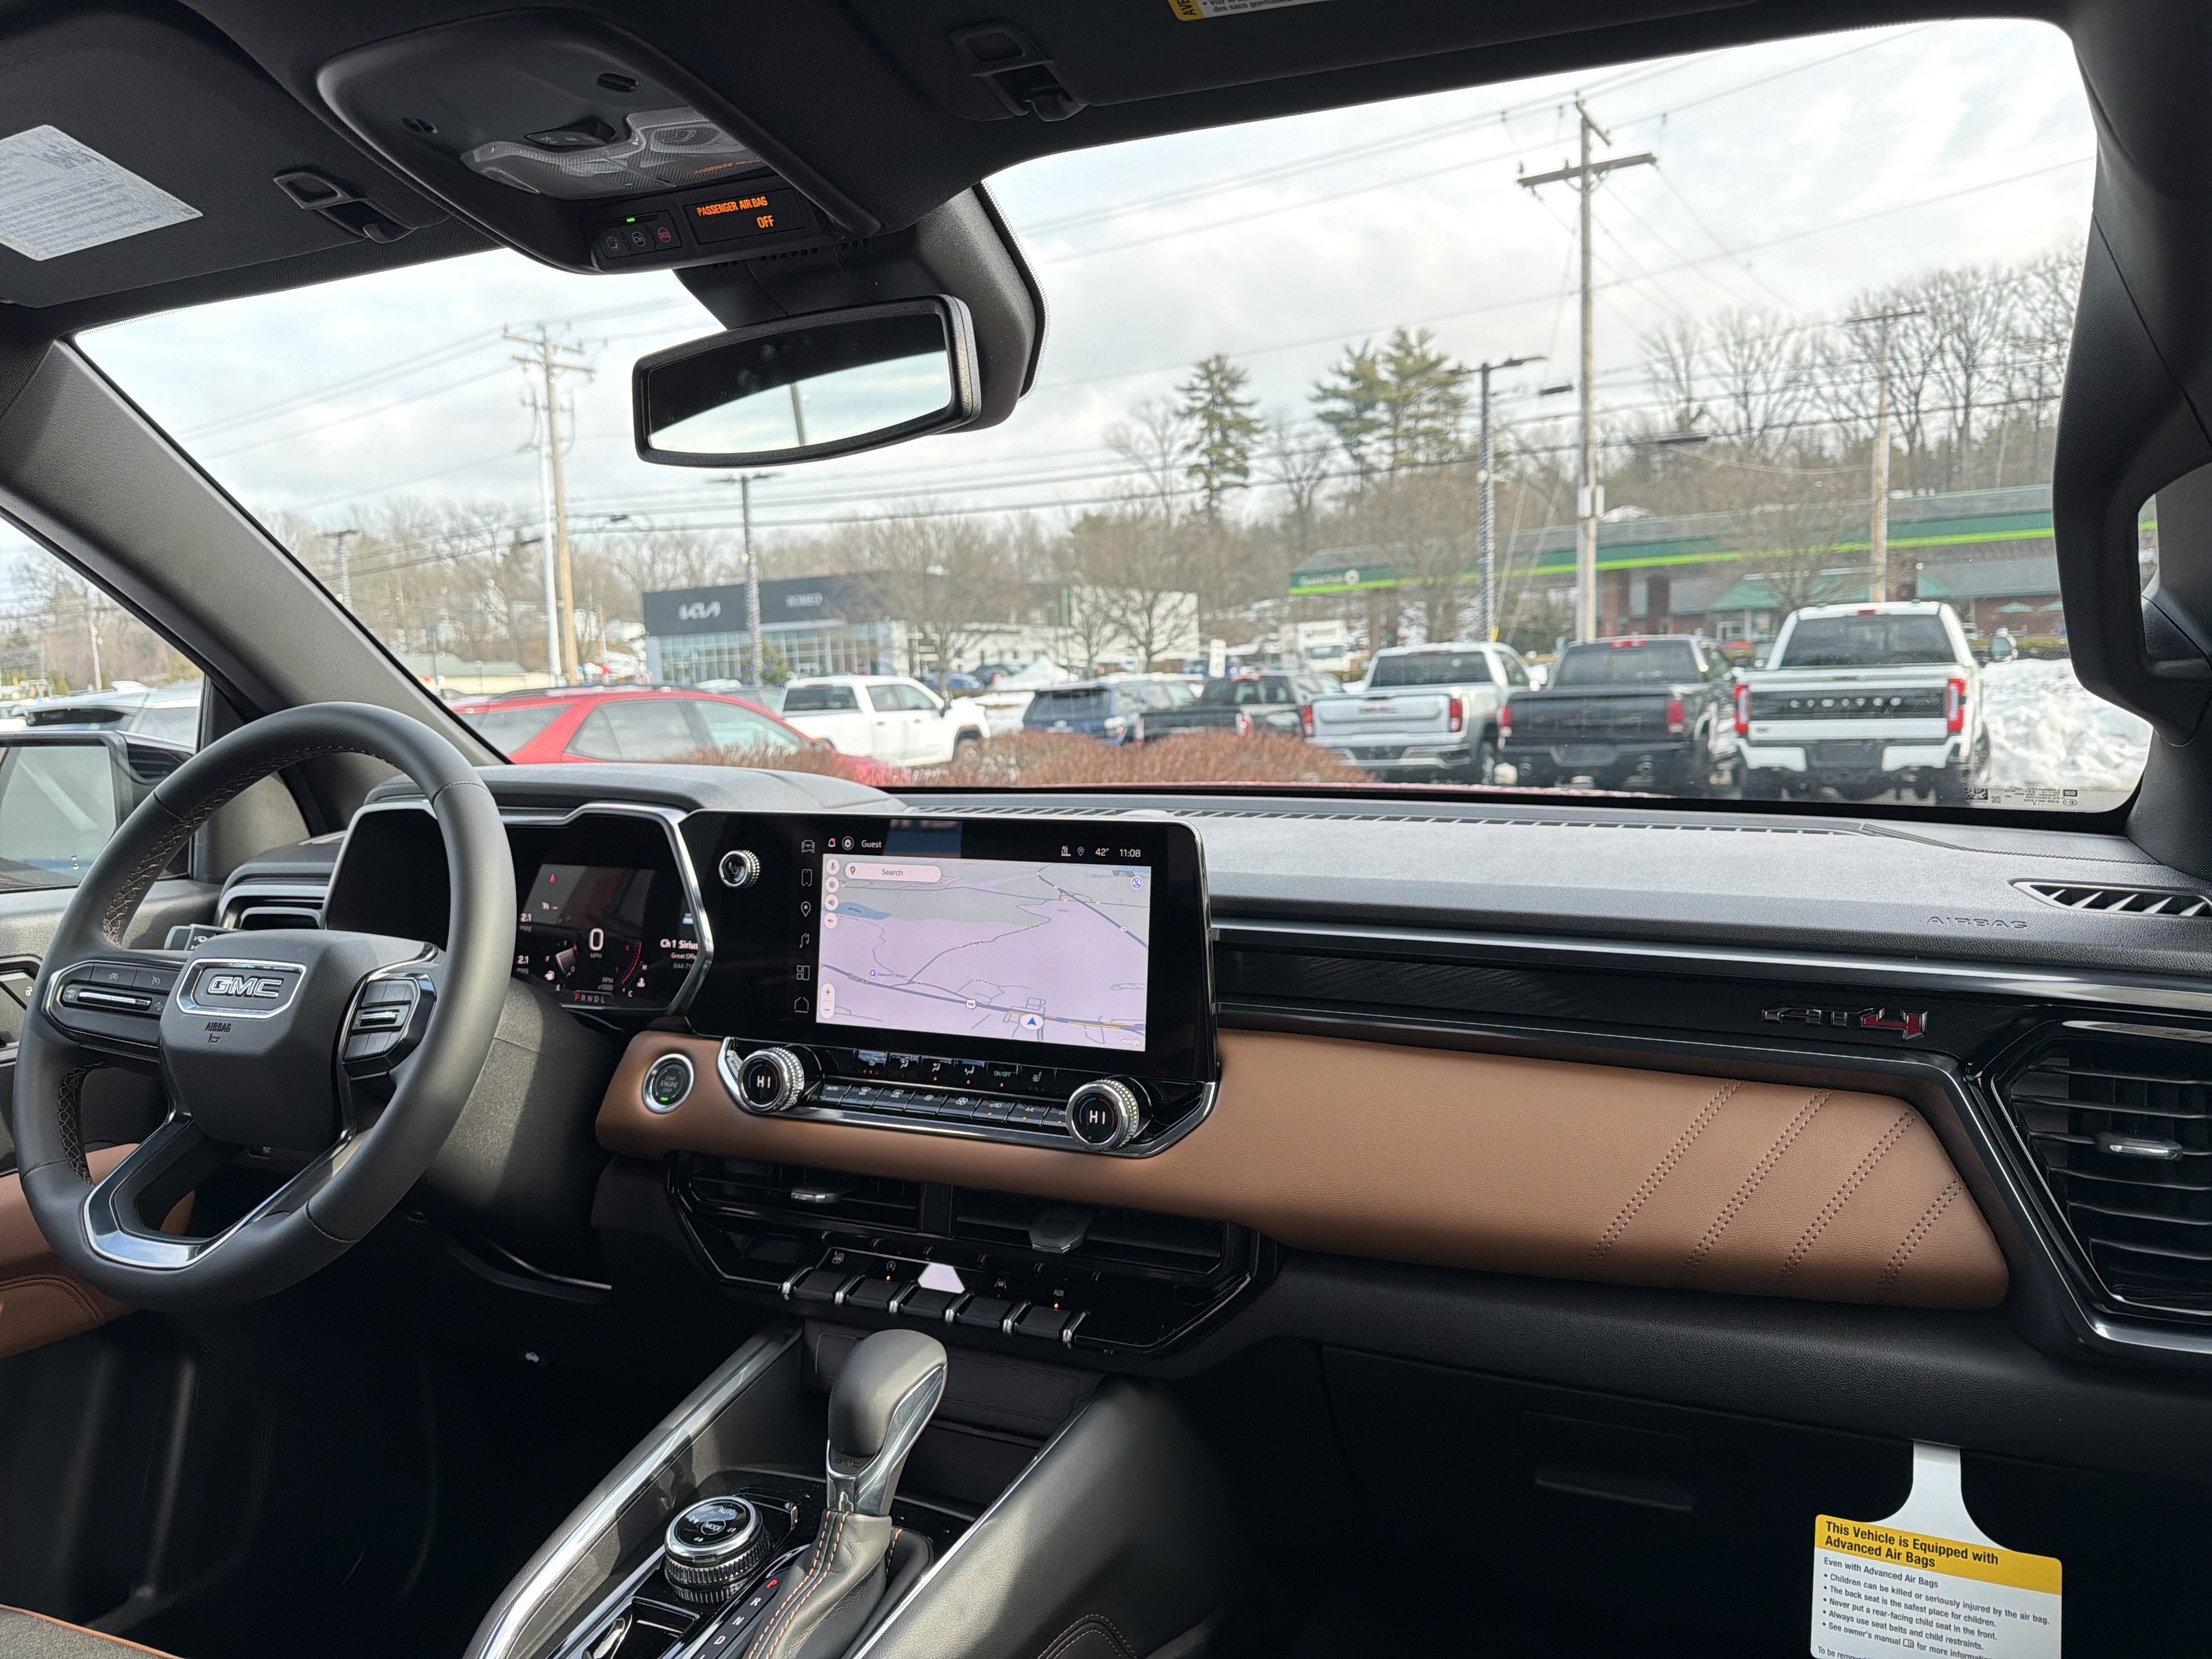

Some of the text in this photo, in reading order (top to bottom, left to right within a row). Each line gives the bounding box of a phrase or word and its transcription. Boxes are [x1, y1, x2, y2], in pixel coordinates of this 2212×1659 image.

[697, 196, 768, 217] PASSENGER AIR BAG
[757, 215, 774, 229] OFF
[861, 839, 882, 848] Guest
[1095, 848, 1109, 856] 42°
[1119, 849, 1141, 857] 11:08
[520, 913, 532, 922] 2.1
[1927, 916, 2028, 929] AIRBAG
[589, 928, 604, 951] 0
[660, 939, 671, 948] Ch
[672, 939, 676, 948] 1
[517, 955, 529, 964] 2.1
[208, 976, 284, 998] GMC
[574, 993, 580, 1002] P
[588, 995, 593, 1003] N
[206, 1022, 232, 1033] AIRBAG
[1118, 1037, 1142, 1046] Google
[757, 1075, 771, 1088] HI
[1089, 1110, 1106, 1125] HI
[1053, 1289, 1065, 1297] AUX
[718, 1506, 736, 1516] AUTO
[704, 1522, 724, 1532] MODE
[1825, 1520, 1999, 1565] This Vehicle is Equipped with
[1825, 1536, 1936, 1568] Advanced Air Bags
[1824, 1557, 1939, 1589] Even with Advanced Air Bags
[768, 1580, 778, 1589] P
[750, 1598, 761, 1606] R
[1830, 1573, 1861, 1587] Children
[1863, 1582, 1877, 1590] can
[1880, 1584, 1889, 1593] be
[1891, 1585, 1912, 1598] killed
[1925, 1595, 1961, 1609] seriously
[1963, 1601, 1990, 1613] injured
[1993, 1607, 2002, 1617] by
[2005, 1609, 2017, 1618] the
[2033, 1614, 2050, 1626] bag.
[1830, 1585, 1997, 1627] The back seat is the safest place for children.
[732, 1617, 744, 1626] N
[1830, 1598, 1850, 1609] Never
[1852, 1604, 1864, 1612] put
[1872, 1609, 1914, 1624] rear-facing
[1915, 1617, 1933, 1627] child
[1936, 1622, 1952, 1631] seat
[1954, 1624, 1961, 1633] in
[1963, 1627, 1975, 1636] the
[1977, 1629, 1997, 1640] front.
[1829, 1610, 1984, 1650] Always use seat belts and child restraints.
[714, 1636, 725, 1644] D
[1829, 1622, 1842, 1632] See
[1844, 1627, 1872, 1639] owner's
[1874, 1634, 1901, 1646] manual
[1916, 1642, 1928, 1651] for
[1929, 1646, 1948, 1656] more
[1818, 1646, 1826, 1655] To
[1827, 1648, 1836, 1657] be
